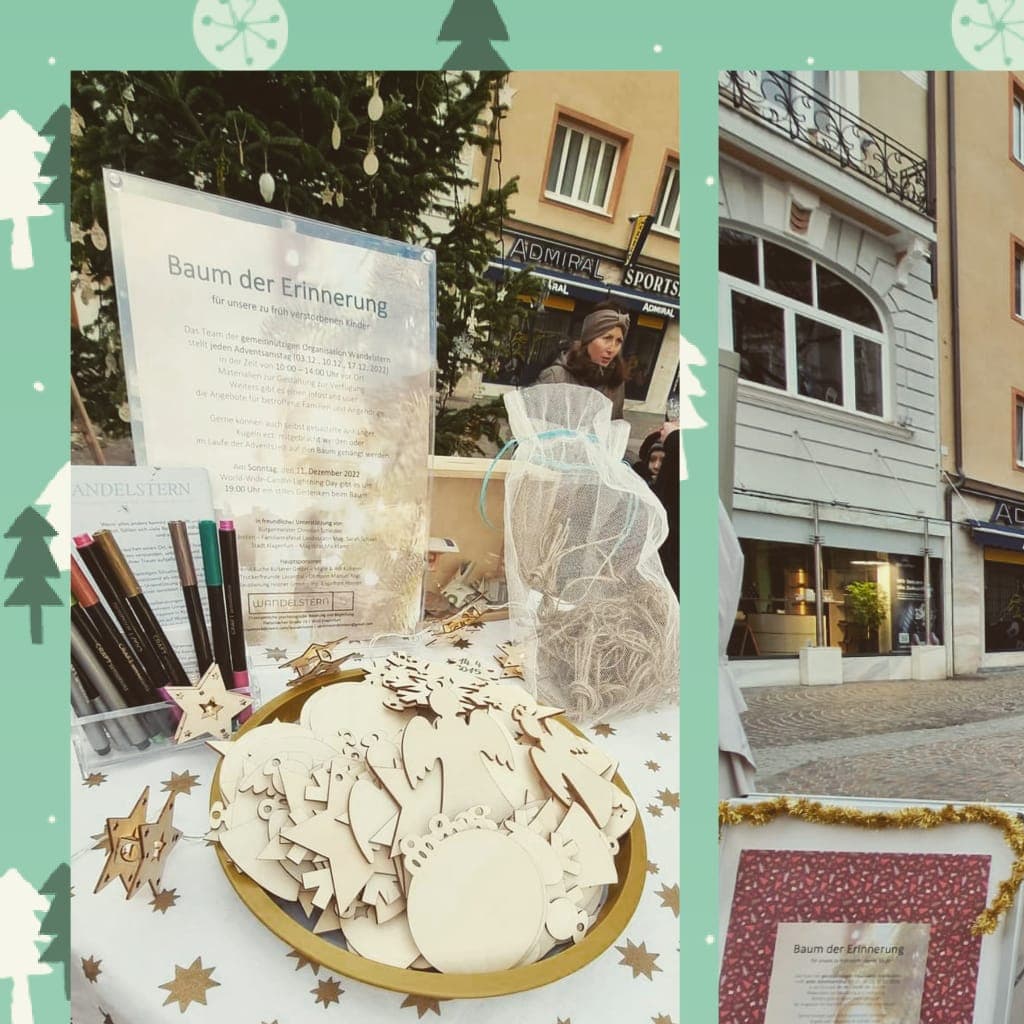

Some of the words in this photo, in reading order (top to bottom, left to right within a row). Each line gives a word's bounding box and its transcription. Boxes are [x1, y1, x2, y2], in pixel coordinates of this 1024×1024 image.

[510, 238, 604, 280] ADMIRAL
[167, 254, 232, 286] Baum
[239, 268, 275, 293] der
[281, 277, 389, 320] Erinnerung
[211, 294, 225, 306] für
[227, 298, 257, 312] unsere
[259, 305, 269, 313] zu
[271, 305, 289, 317] früh
[345, 317, 370, 329] Kinder
[642, 302, 675, 318] ADMIRAL
[793, 944, 824, 954] Baum
[826, 944, 845, 954] der
[847, 944, 905, 956] Erinnerung
